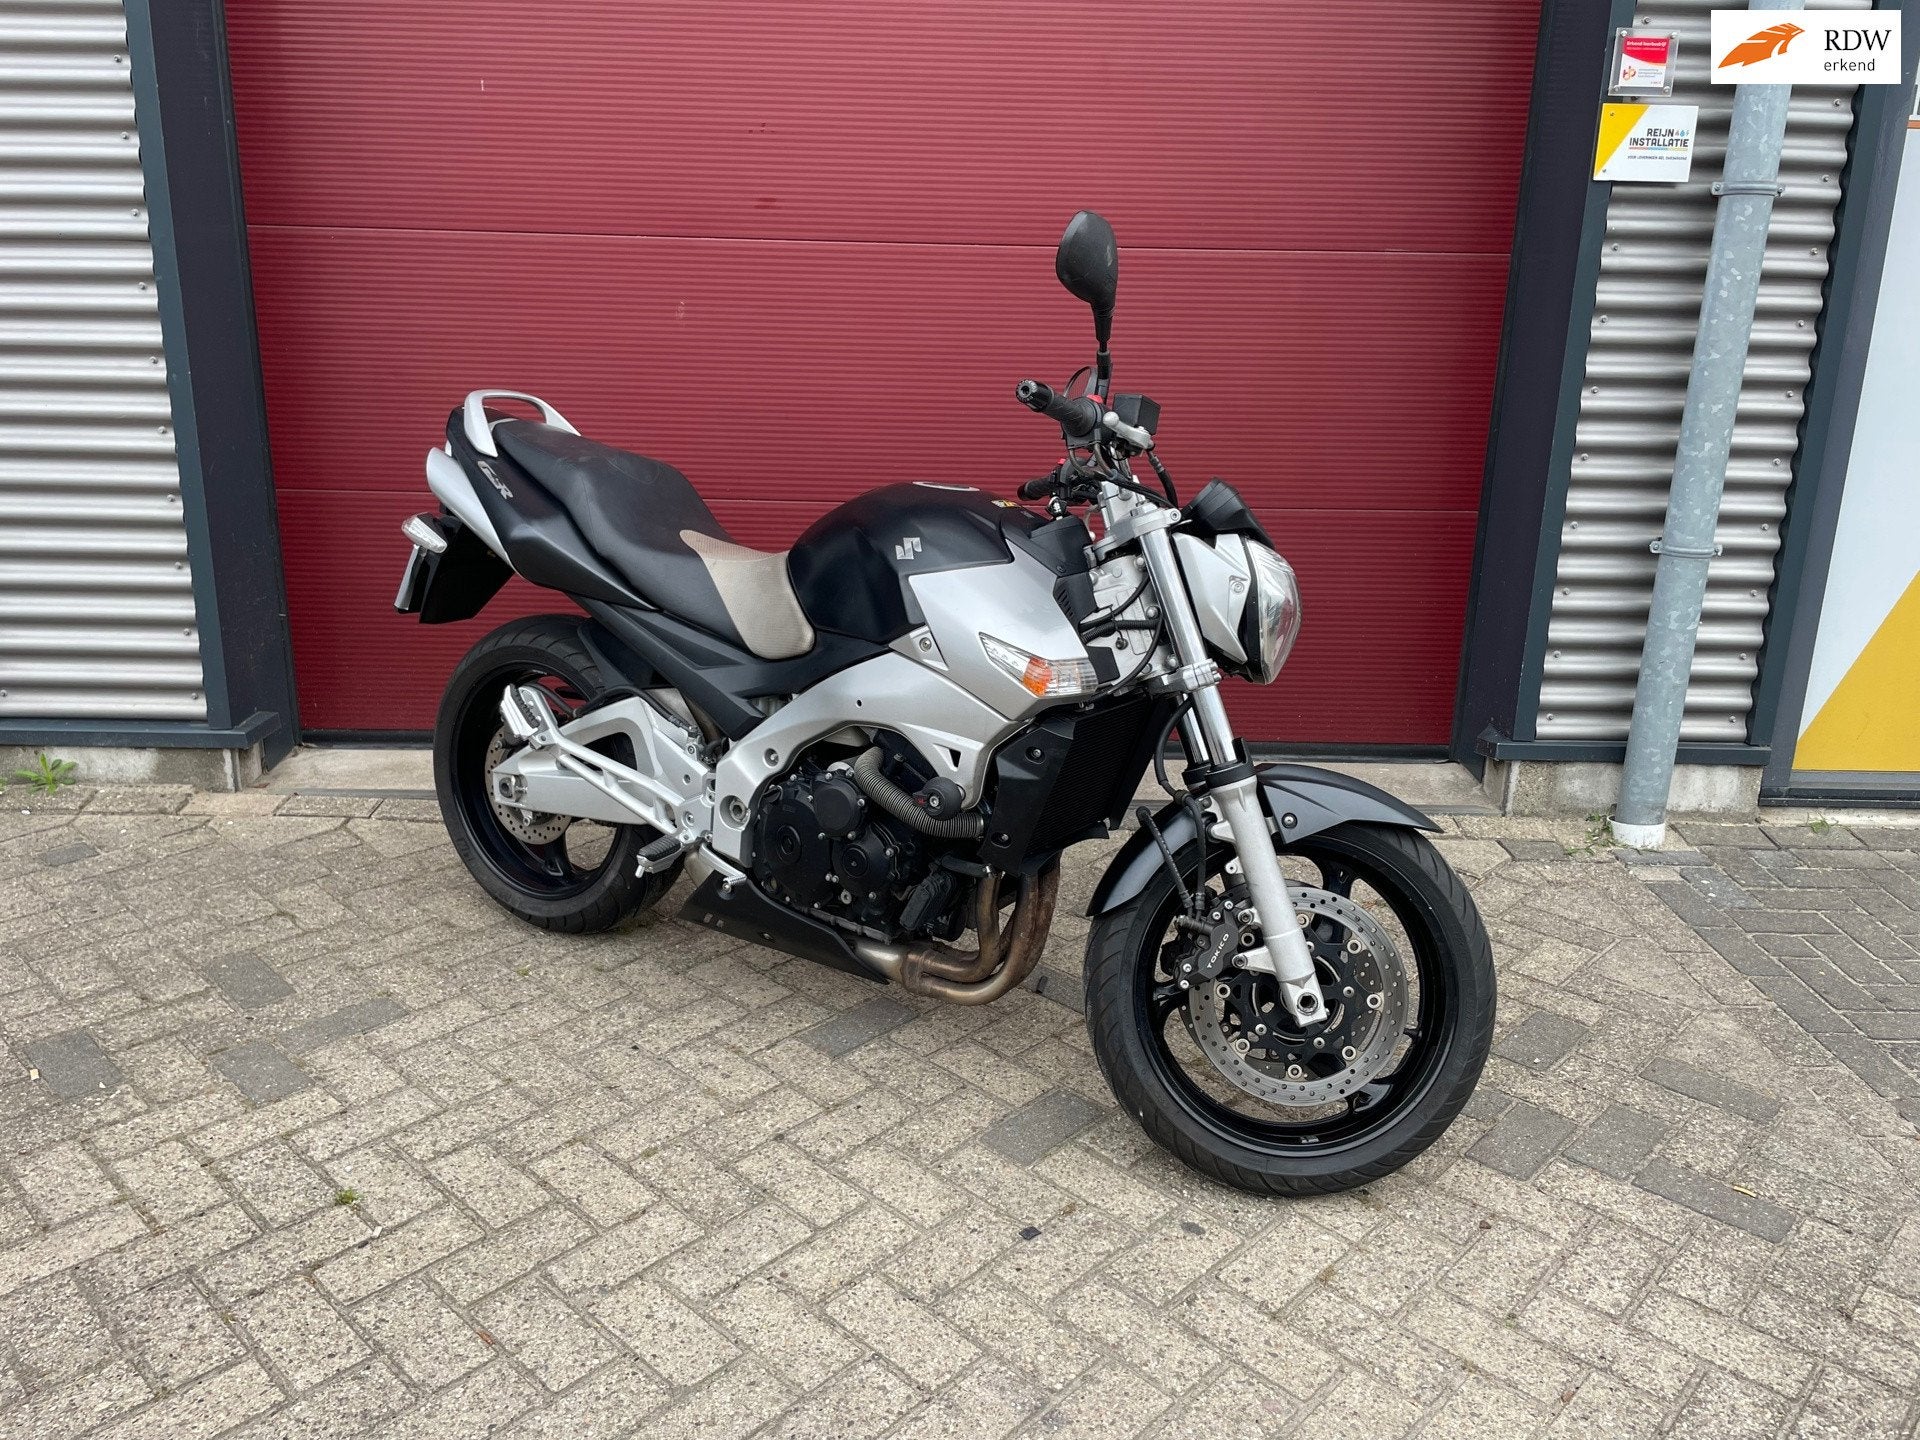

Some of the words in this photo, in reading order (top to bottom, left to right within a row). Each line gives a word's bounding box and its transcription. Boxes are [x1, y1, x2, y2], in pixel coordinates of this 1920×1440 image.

[1646, 128, 1675, 137] REIJN
[1629, 137, 1690, 148] INSTALLATIE
[1206, 933, 1230, 969] TOKICO
